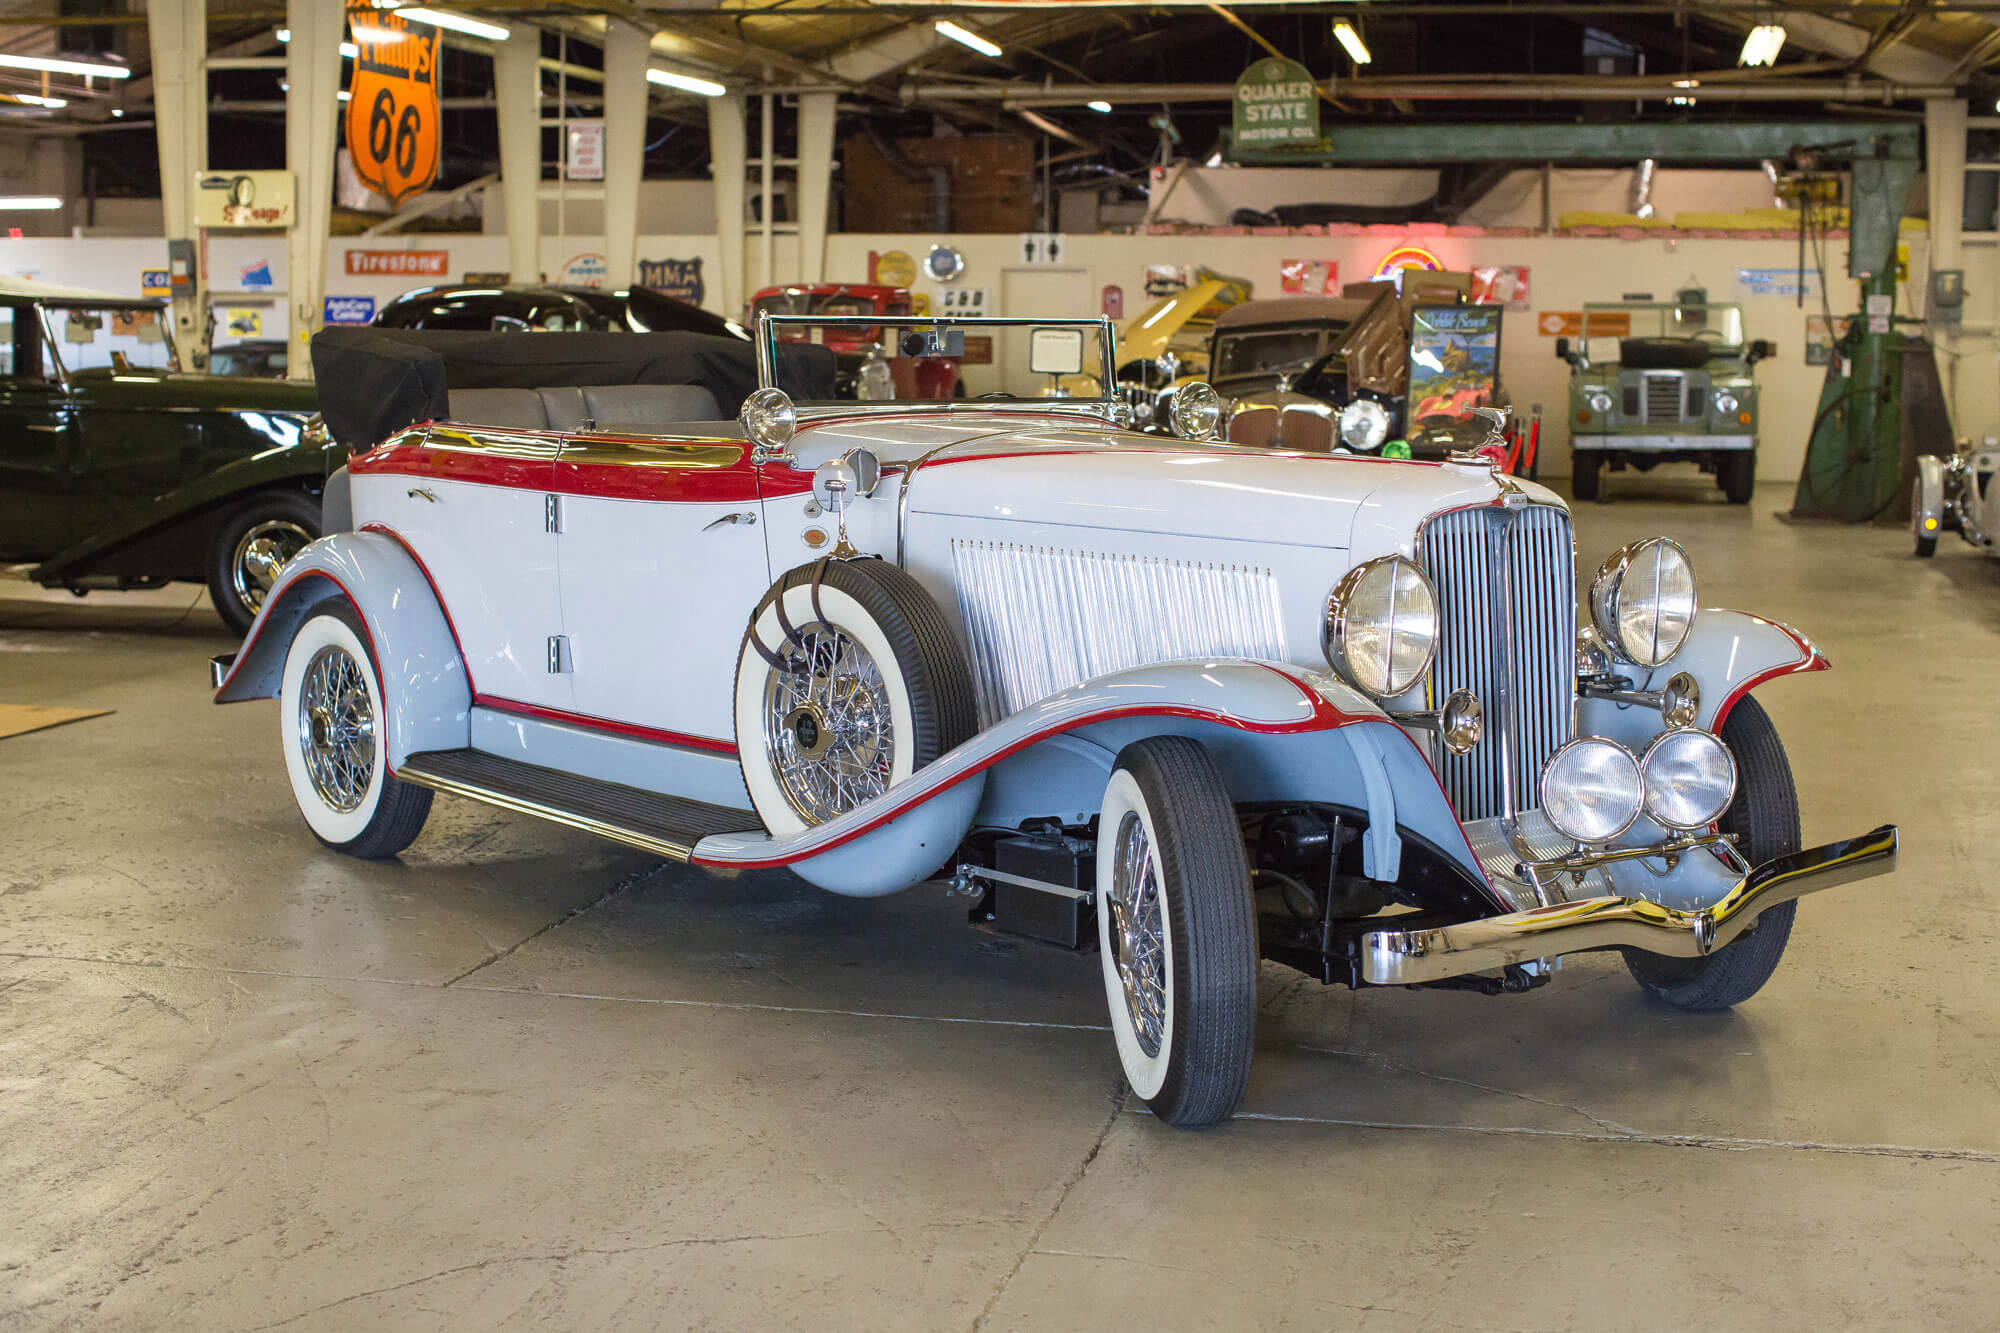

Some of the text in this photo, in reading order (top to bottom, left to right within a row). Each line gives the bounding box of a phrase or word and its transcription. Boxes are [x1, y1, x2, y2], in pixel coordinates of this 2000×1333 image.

[1239, 82, 1313, 103] QUAKER
[1246, 103, 1307, 121] STATE
[369, 88, 421, 178] 66
[1240, 126, 1315, 140] MOTOR OIL
[350, 253, 443, 272] Firestone
[645, 264, 697, 286] MMA
